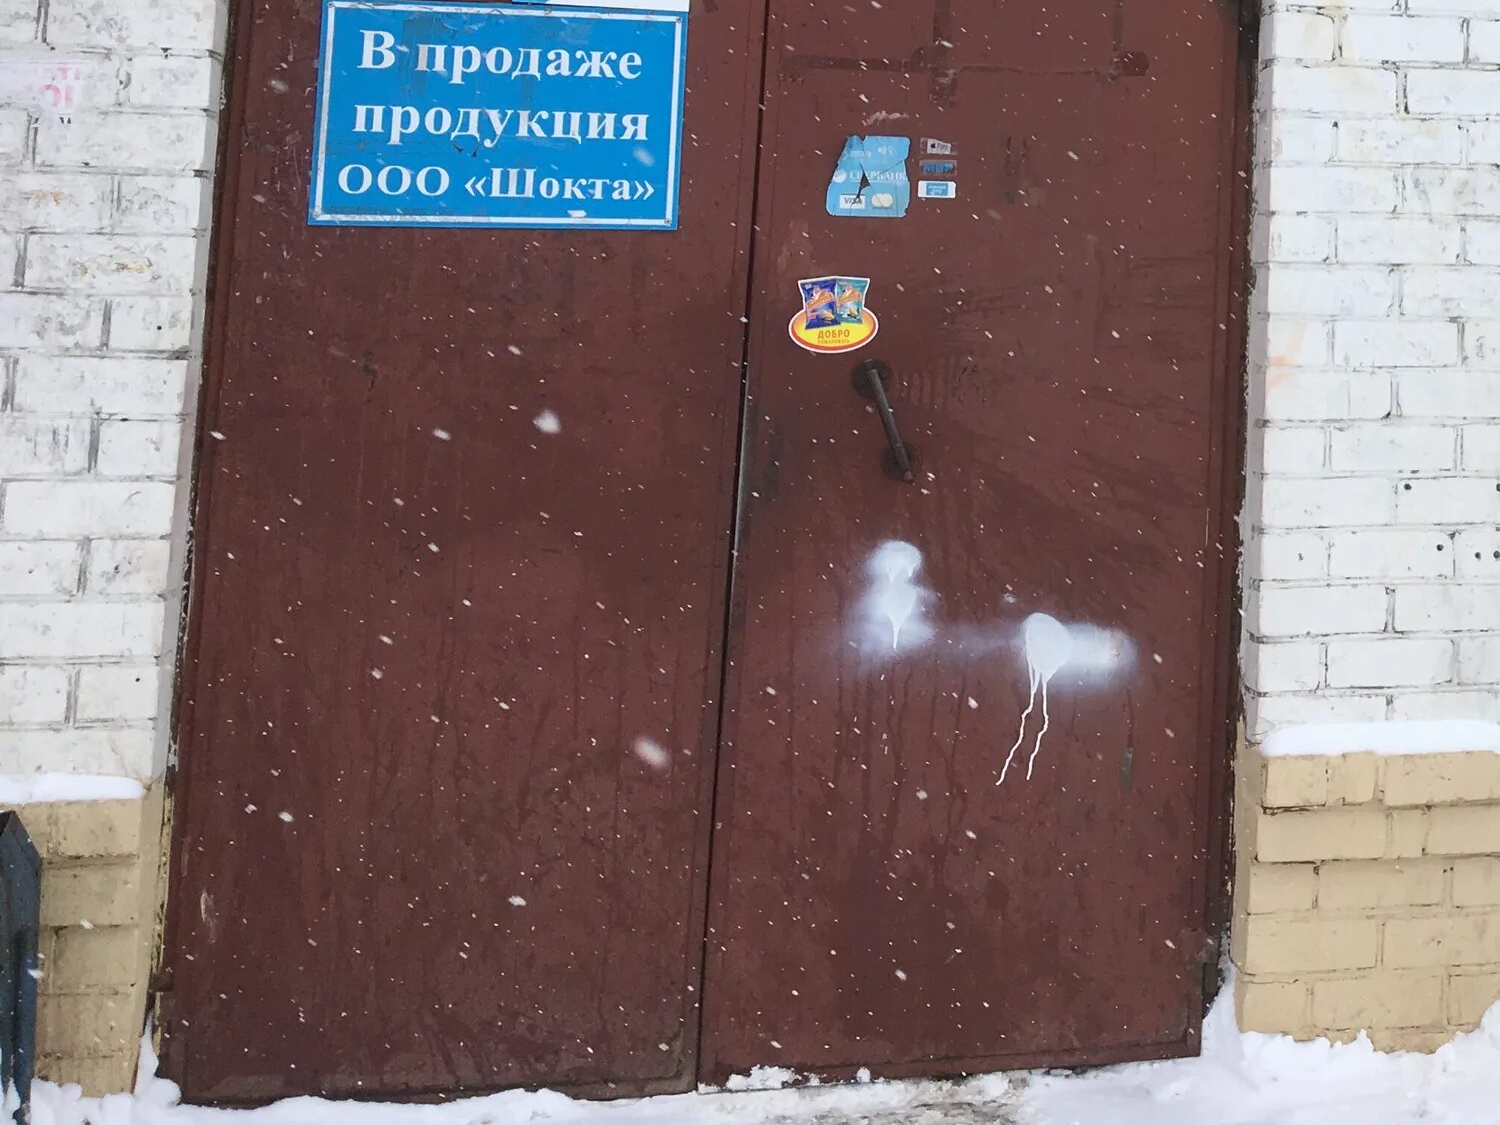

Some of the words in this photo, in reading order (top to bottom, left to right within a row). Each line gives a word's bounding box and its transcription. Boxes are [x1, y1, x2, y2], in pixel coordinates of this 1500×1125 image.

[357, 29, 396, 69] В
[414, 42, 643, 85] продаже
[352, 104, 649, 148] продукция
[338, 164, 450, 196] ООО
[464, 167, 656, 202] «Шокта»
[817, 329, 850, 339] ДОБРО
